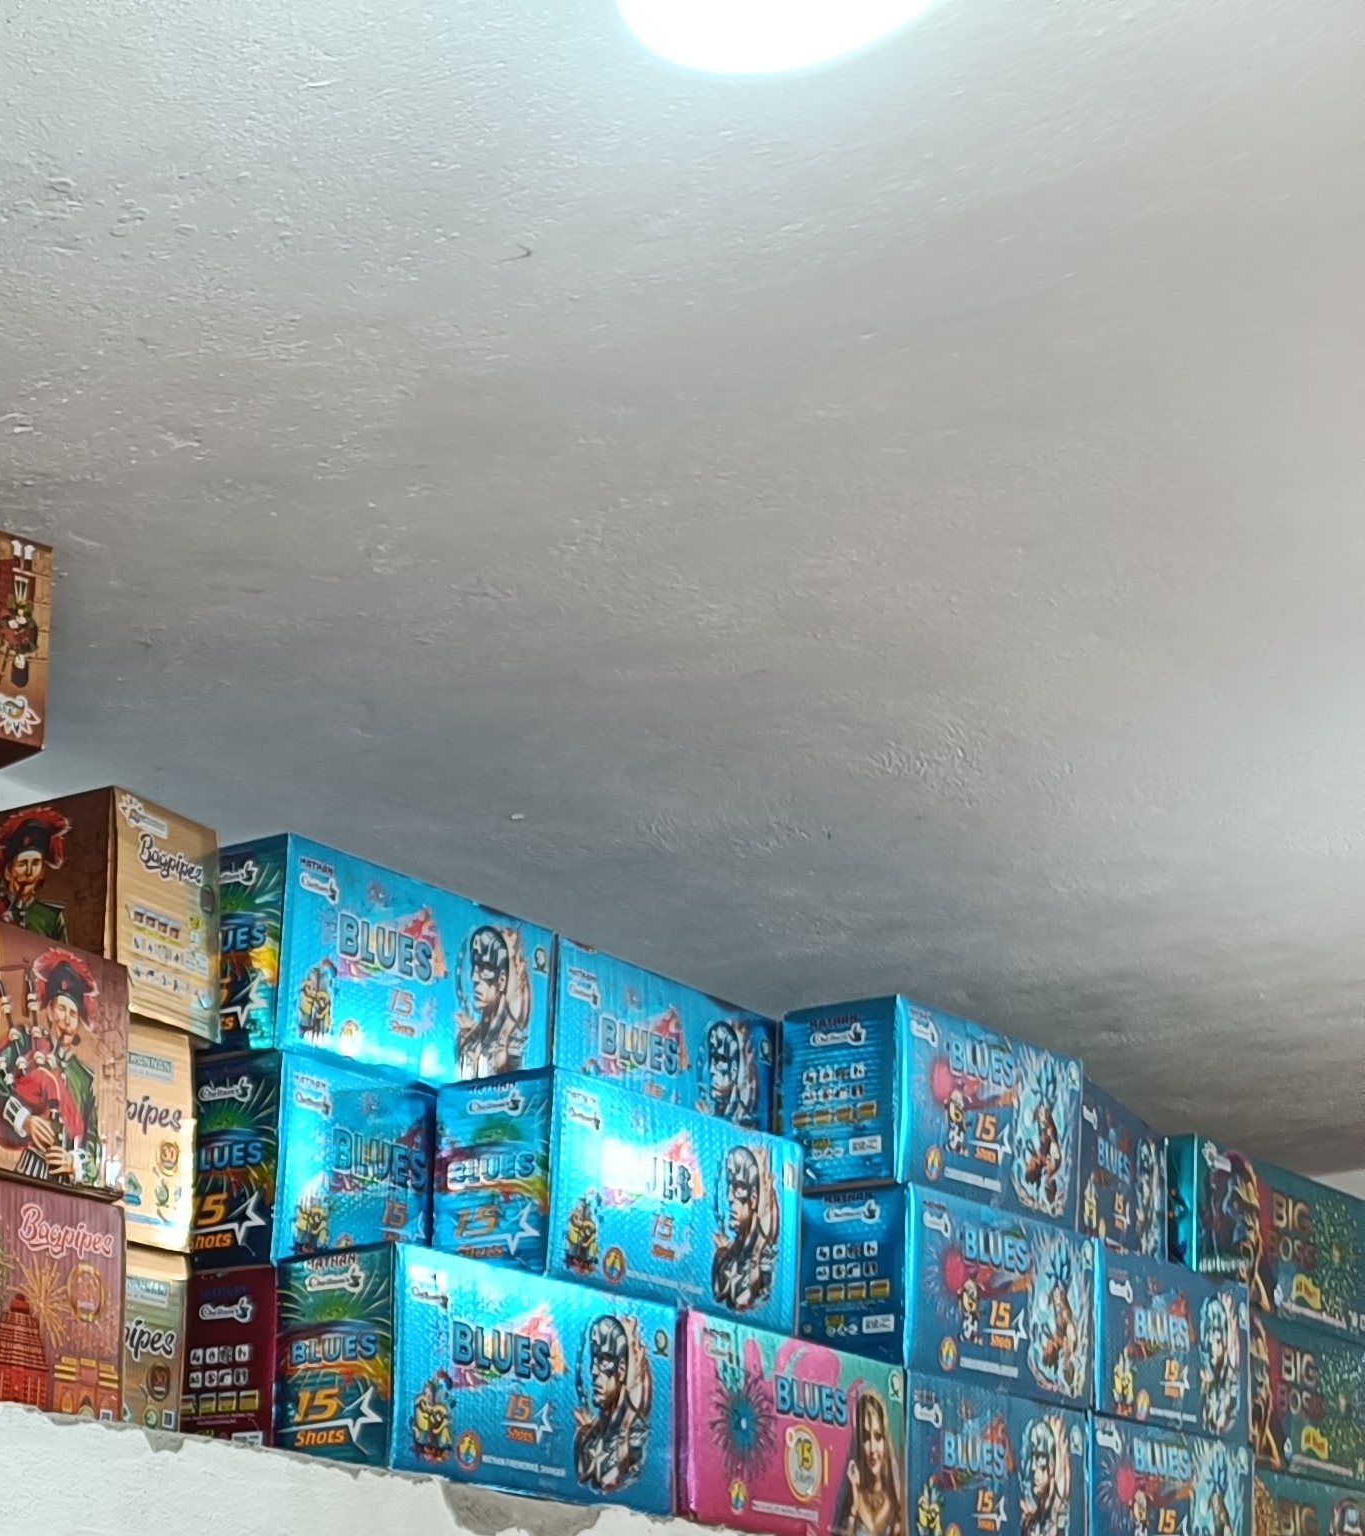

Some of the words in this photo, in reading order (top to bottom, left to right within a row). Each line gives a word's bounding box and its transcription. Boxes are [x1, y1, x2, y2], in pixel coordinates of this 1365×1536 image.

[138, 832, 203, 884] Bagpipes
[337, 910, 433, 983] BLUES
[947, 1038, 1015, 1089] BLUES
[975, 1114, 996, 1140] 15
[19, 1203, 115, 1259] Bagpipes
[963, 1228, 1029, 1274] BLUES
[988, 1301, 1011, 1327] 15
[290, 1333, 378, 1366] BLUES
[451, 1321, 552, 1383] BLUES
[295, 1387, 340, 1421] 15
[504, 1392, 533, 1421] 15
[774, 1375, 848, 1427] BLUES
[294, 1426, 346, 1447] Shots
[795, 1438, 815, 1472] 15
